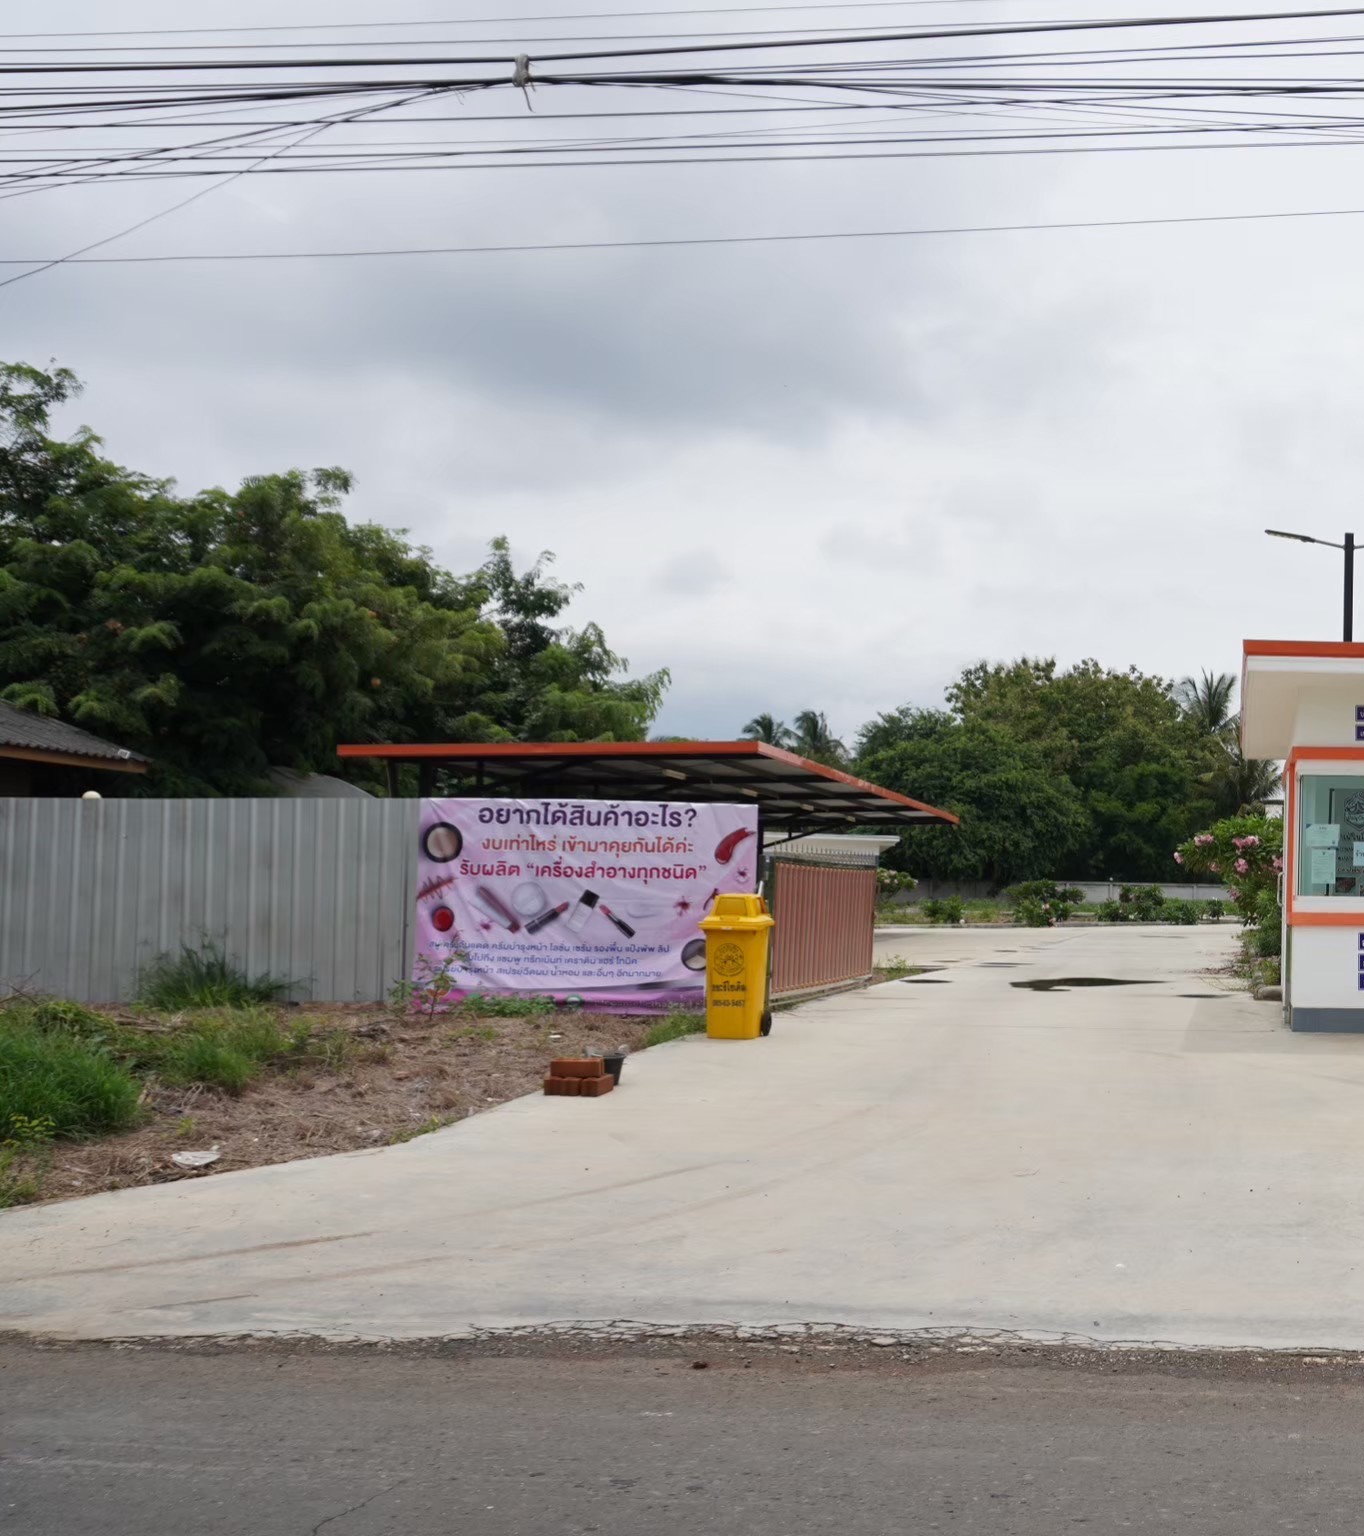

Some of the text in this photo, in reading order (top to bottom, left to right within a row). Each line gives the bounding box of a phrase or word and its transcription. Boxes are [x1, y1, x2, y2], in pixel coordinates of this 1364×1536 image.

[478, 802, 698, 828] อยากได้สินค้าอะไร?
[481, 834, 694, 859] งบเท่าไหร่ เข้ามาคุยกันได้ค่ะ
[459, 859, 521, 877] รับผลิต
